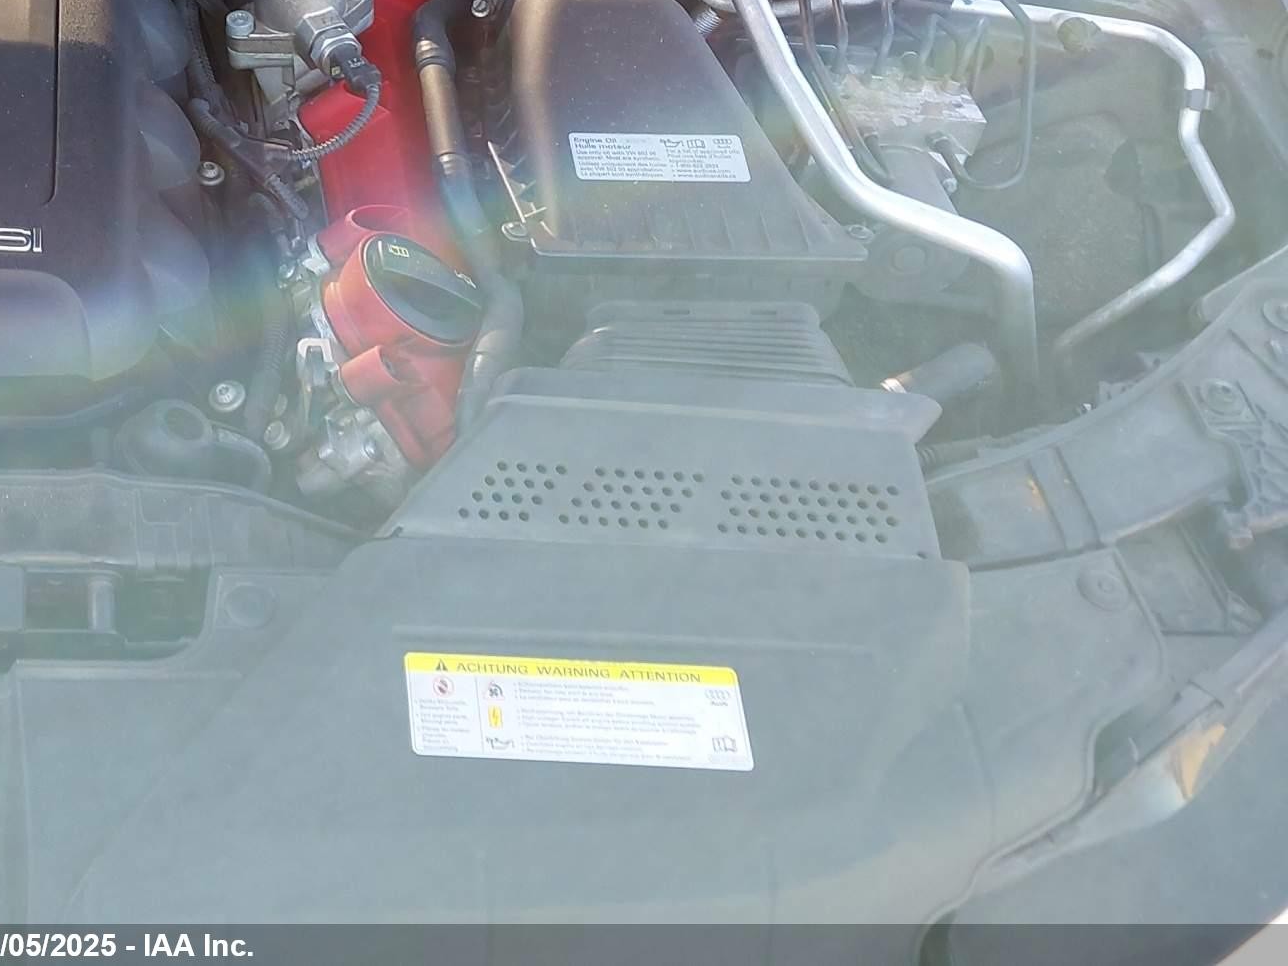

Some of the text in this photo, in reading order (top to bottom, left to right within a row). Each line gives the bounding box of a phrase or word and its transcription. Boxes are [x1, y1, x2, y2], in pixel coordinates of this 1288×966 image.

[456, 662, 701, 683] ACHTUNG WARNING ATTENTION
